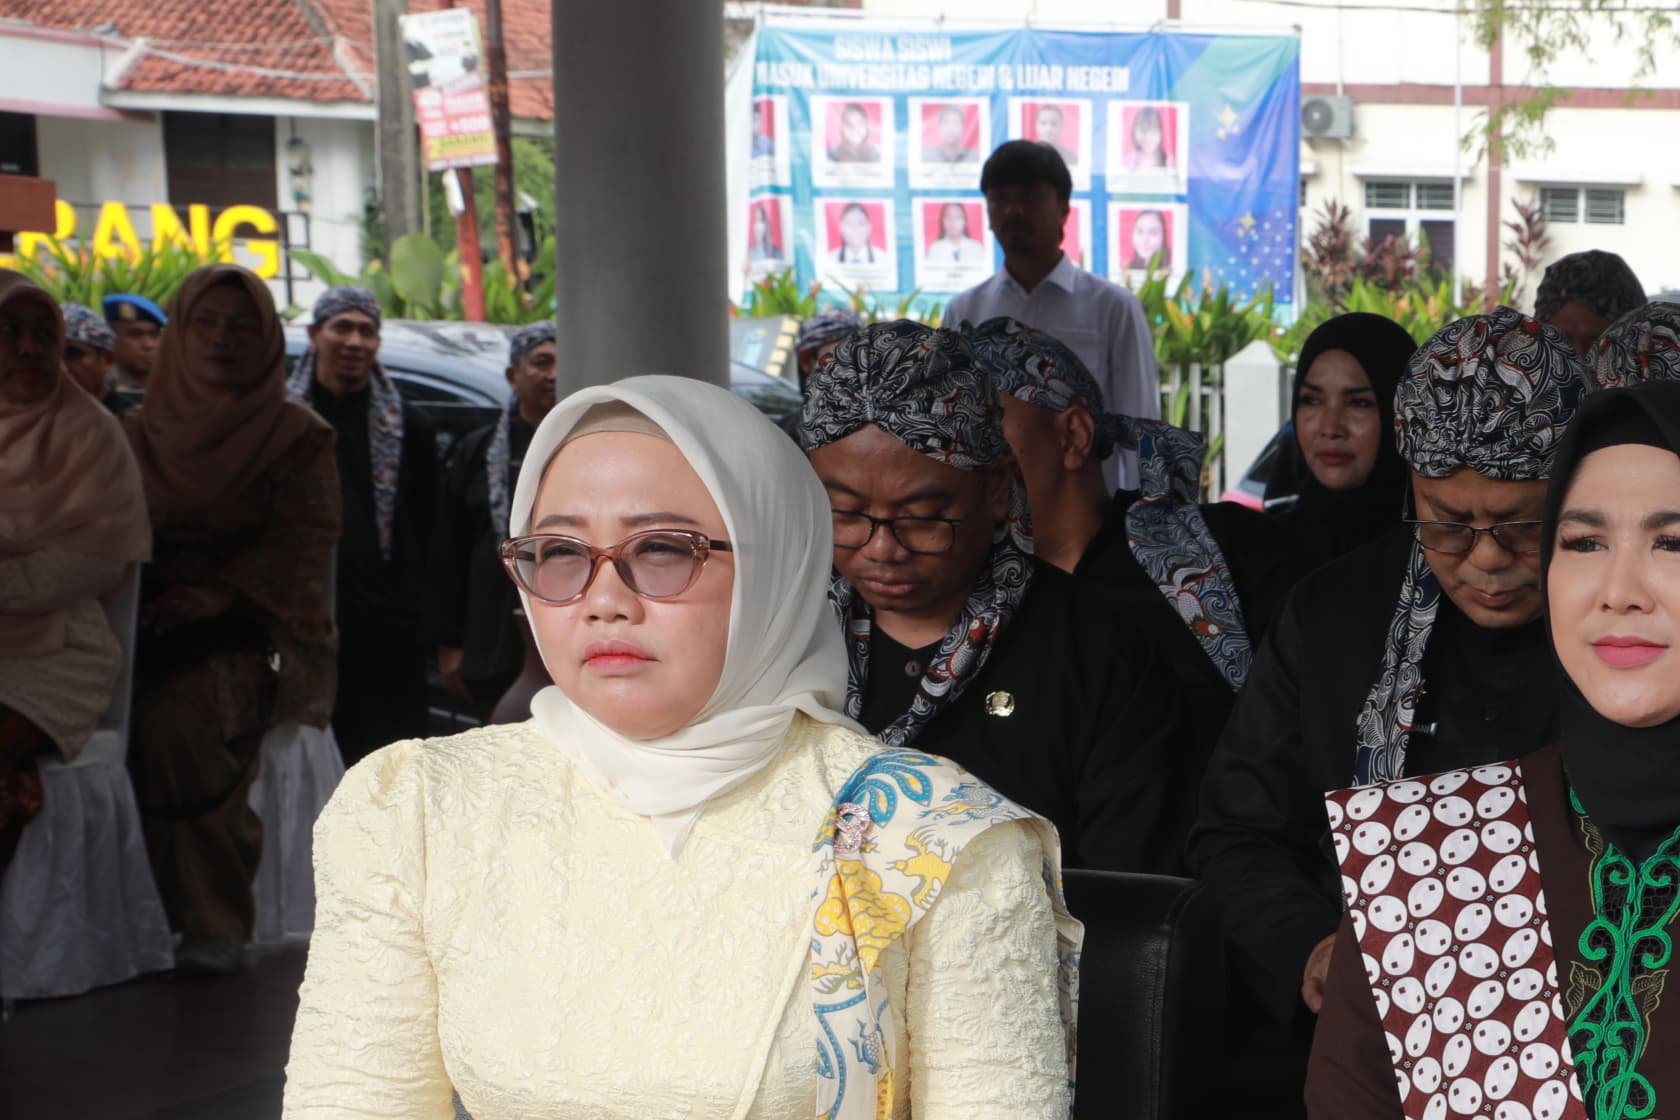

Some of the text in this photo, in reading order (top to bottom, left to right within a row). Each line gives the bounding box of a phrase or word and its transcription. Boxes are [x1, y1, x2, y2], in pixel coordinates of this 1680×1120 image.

[834, 33, 896, 60] SISWA
[817, 63, 930, 90] UNIVERSITAS
[933, 64, 994, 91] NEGERI
[998, 66, 1013, 90] &
[1017, 65, 1062, 90] LUAR
[1066, 66, 1130, 92] NEGERI
[0, 199, 281, 280] RANG
